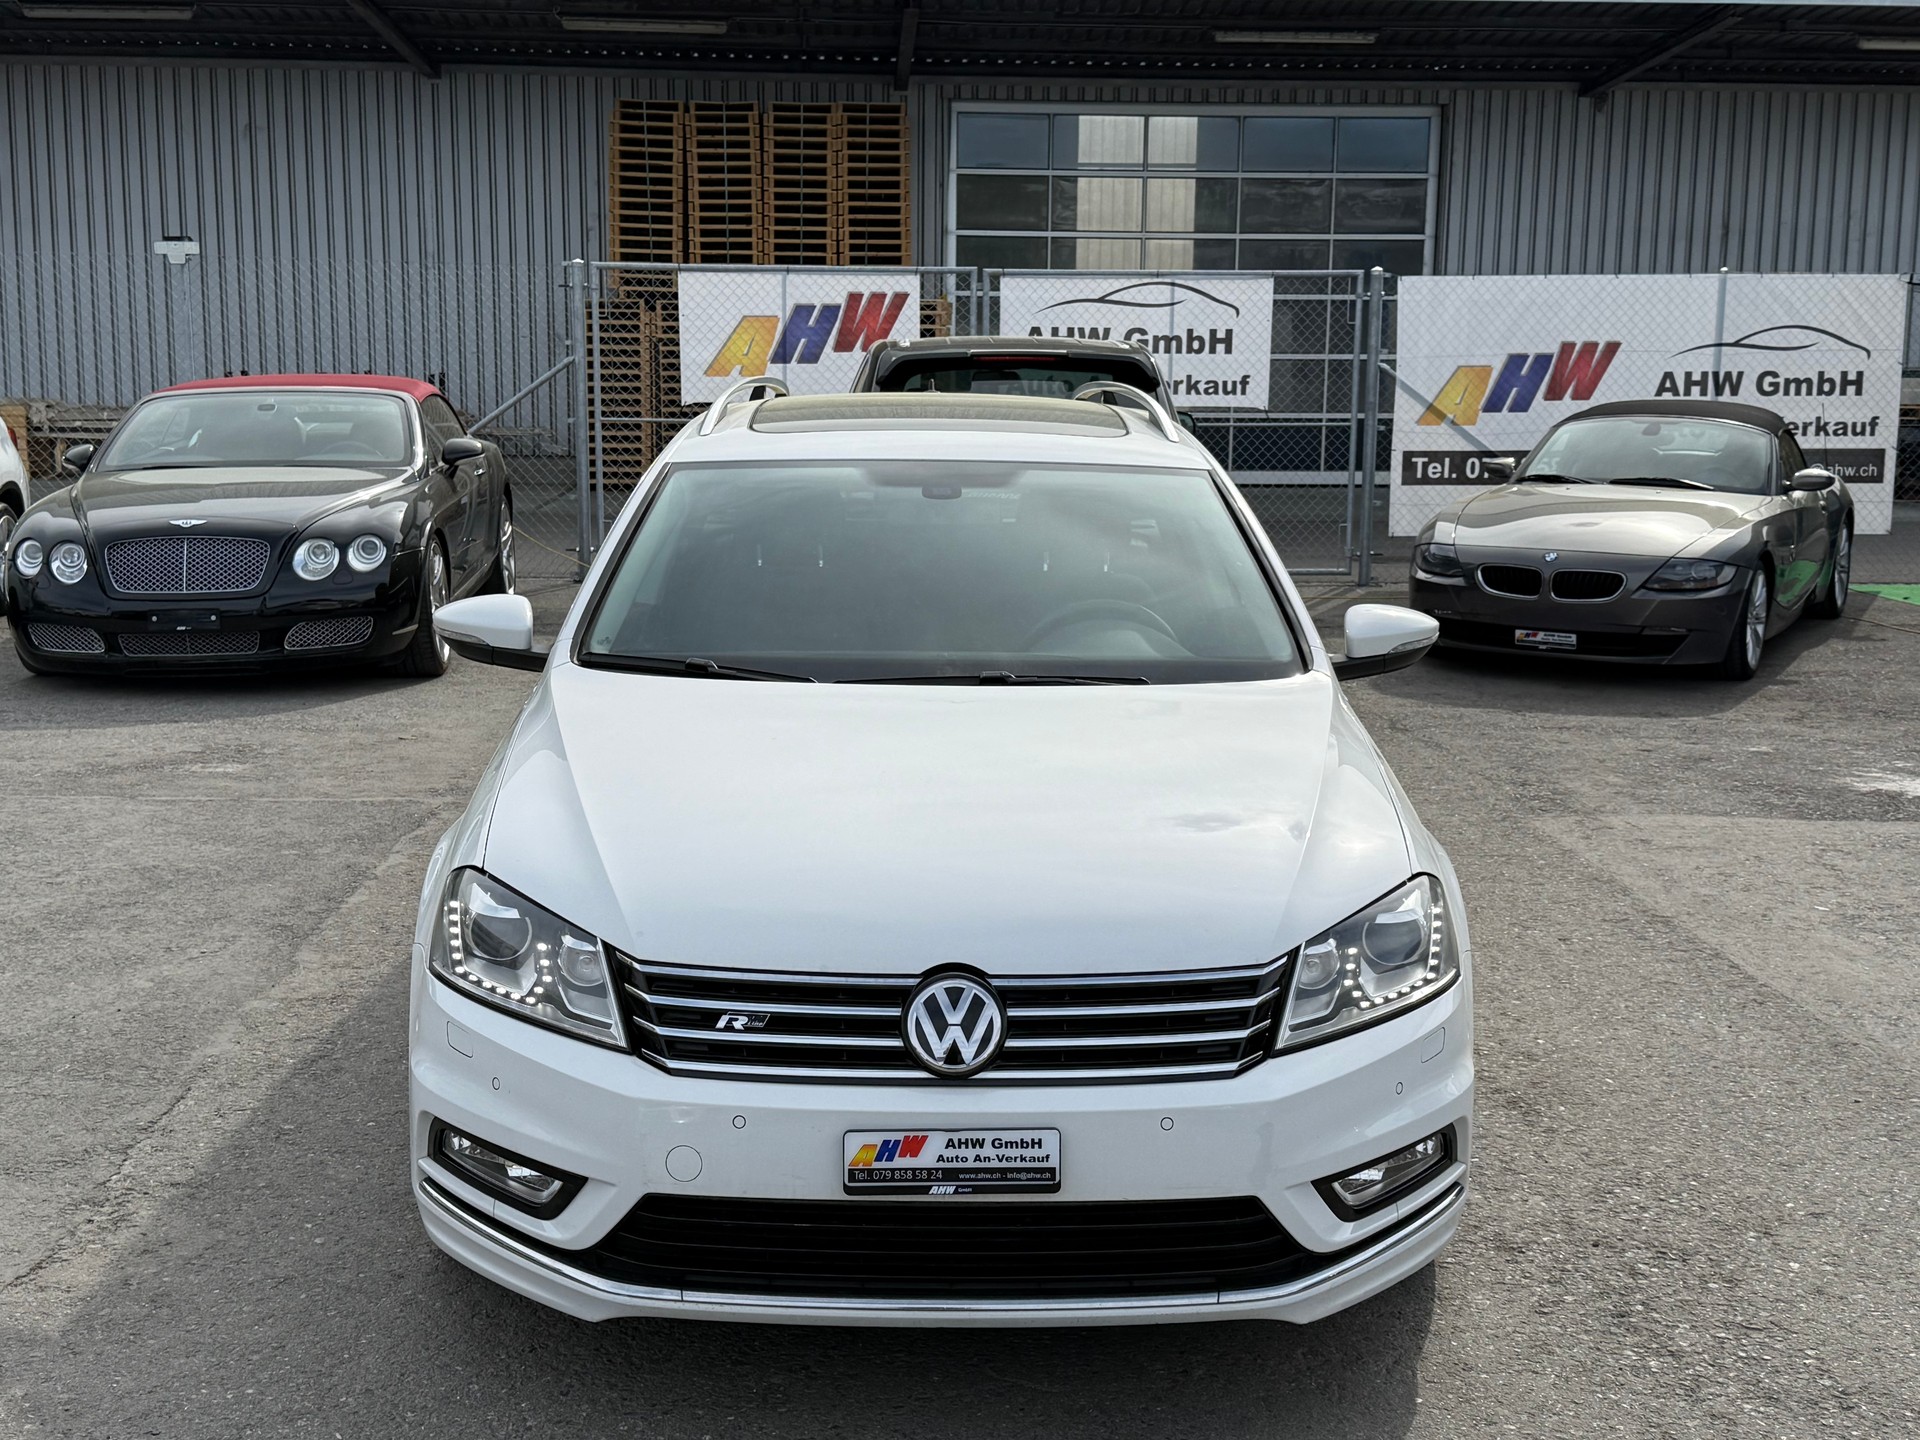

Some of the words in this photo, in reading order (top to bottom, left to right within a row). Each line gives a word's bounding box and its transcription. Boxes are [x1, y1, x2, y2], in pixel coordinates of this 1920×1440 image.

[704, 291, 910, 377] AHW
[1415, 341, 1622, 426] AHW
[1654, 371, 1744, 397] AHW
[1755, 371, 1864, 397] GmbH
[1411, 457, 1457, 479] Tel.
[848, 1135, 929, 1167] AHW
[945, 1138, 985, 1149] AHW
[991, 1138, 1042, 1149] GmbH
[936, 1154, 969, 1163] Auto
[973, 1154, 1051, 1163] An-Verkauf
[853, 1170, 870, 1180] Tel.
[873, 1170, 891, 1180] 079
[894, 1170, 912, 1180] 858
[915, 1170, 927, 1180] 58
[930, 1170, 942, 1180] 24
[929, 1186, 956, 1194] AHW
